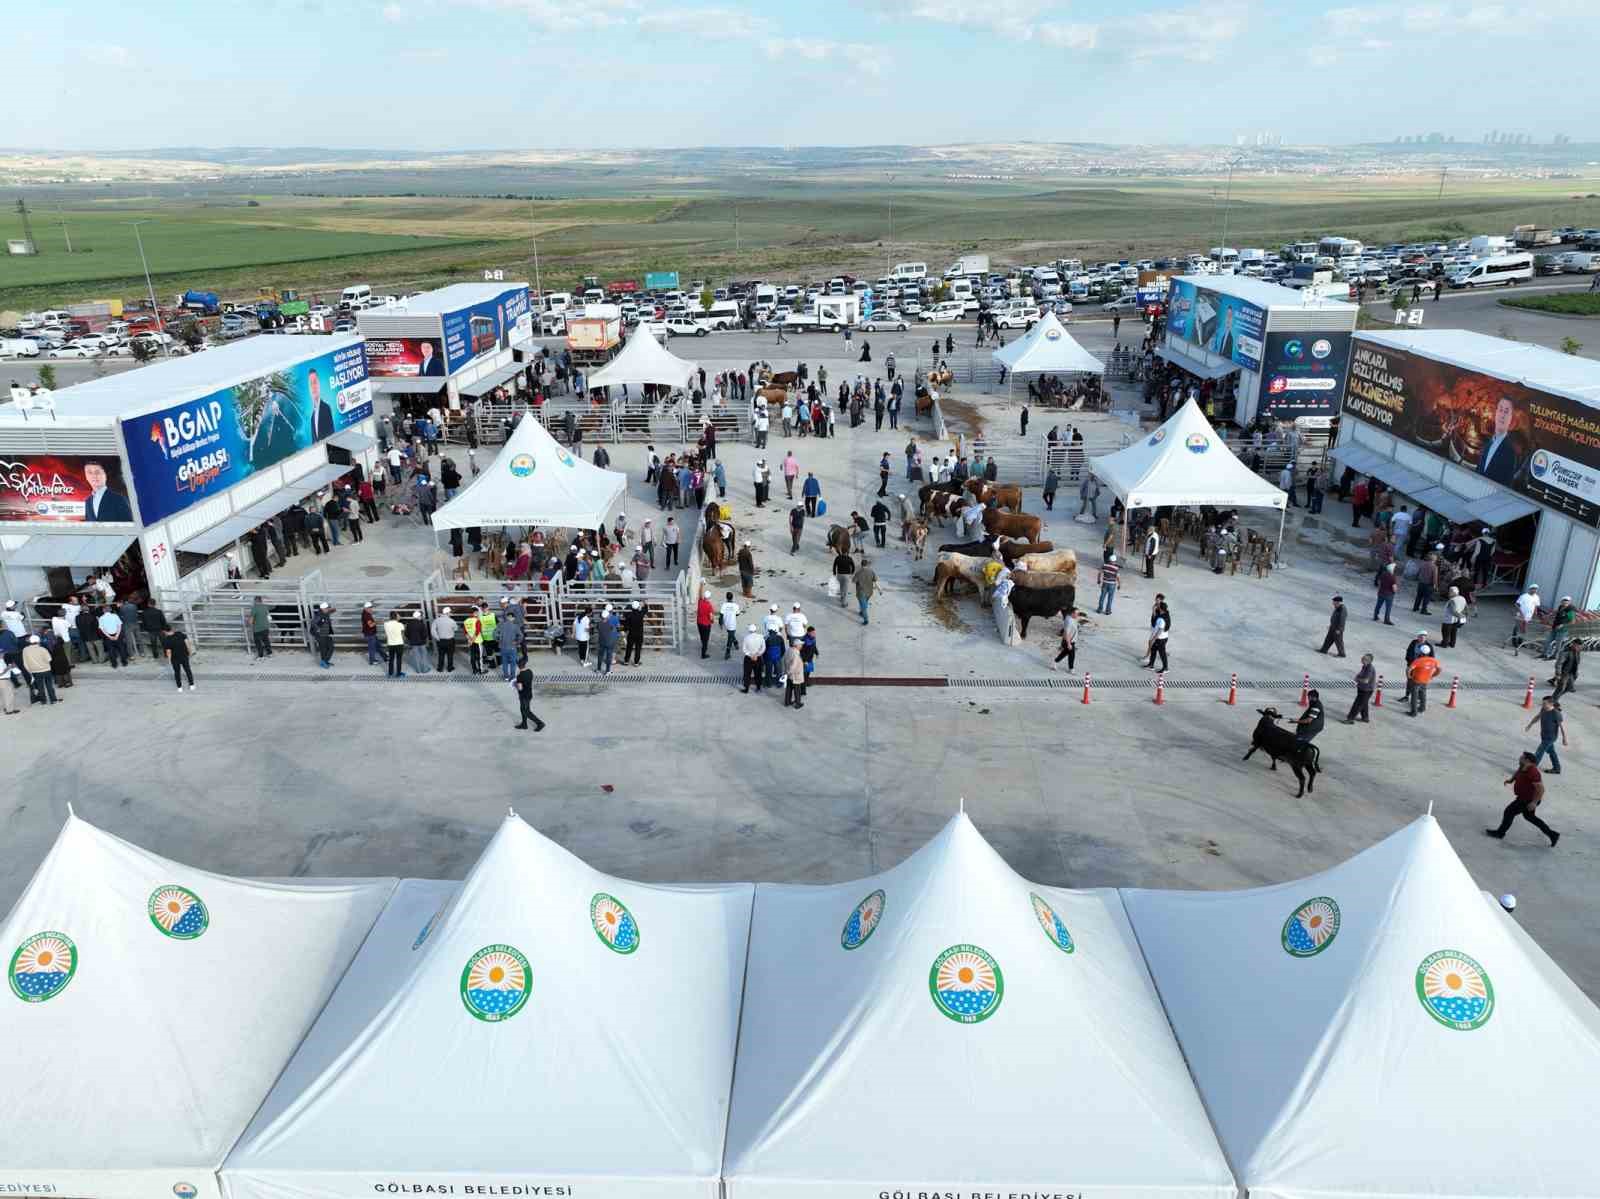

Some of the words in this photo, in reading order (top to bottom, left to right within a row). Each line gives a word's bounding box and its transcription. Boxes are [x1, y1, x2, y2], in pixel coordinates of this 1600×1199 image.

[1352, 362, 1373, 379] GİZLİ
[1354, 348, 1388, 370] ANKARA
[1349, 377, 1406, 413] HAZİNESİNE
[164, 401, 223, 448] BGMP
[178, 448, 228, 482] GÖLBAŞI
[464, 1184, 572, 1196] BELEDİYESİ
